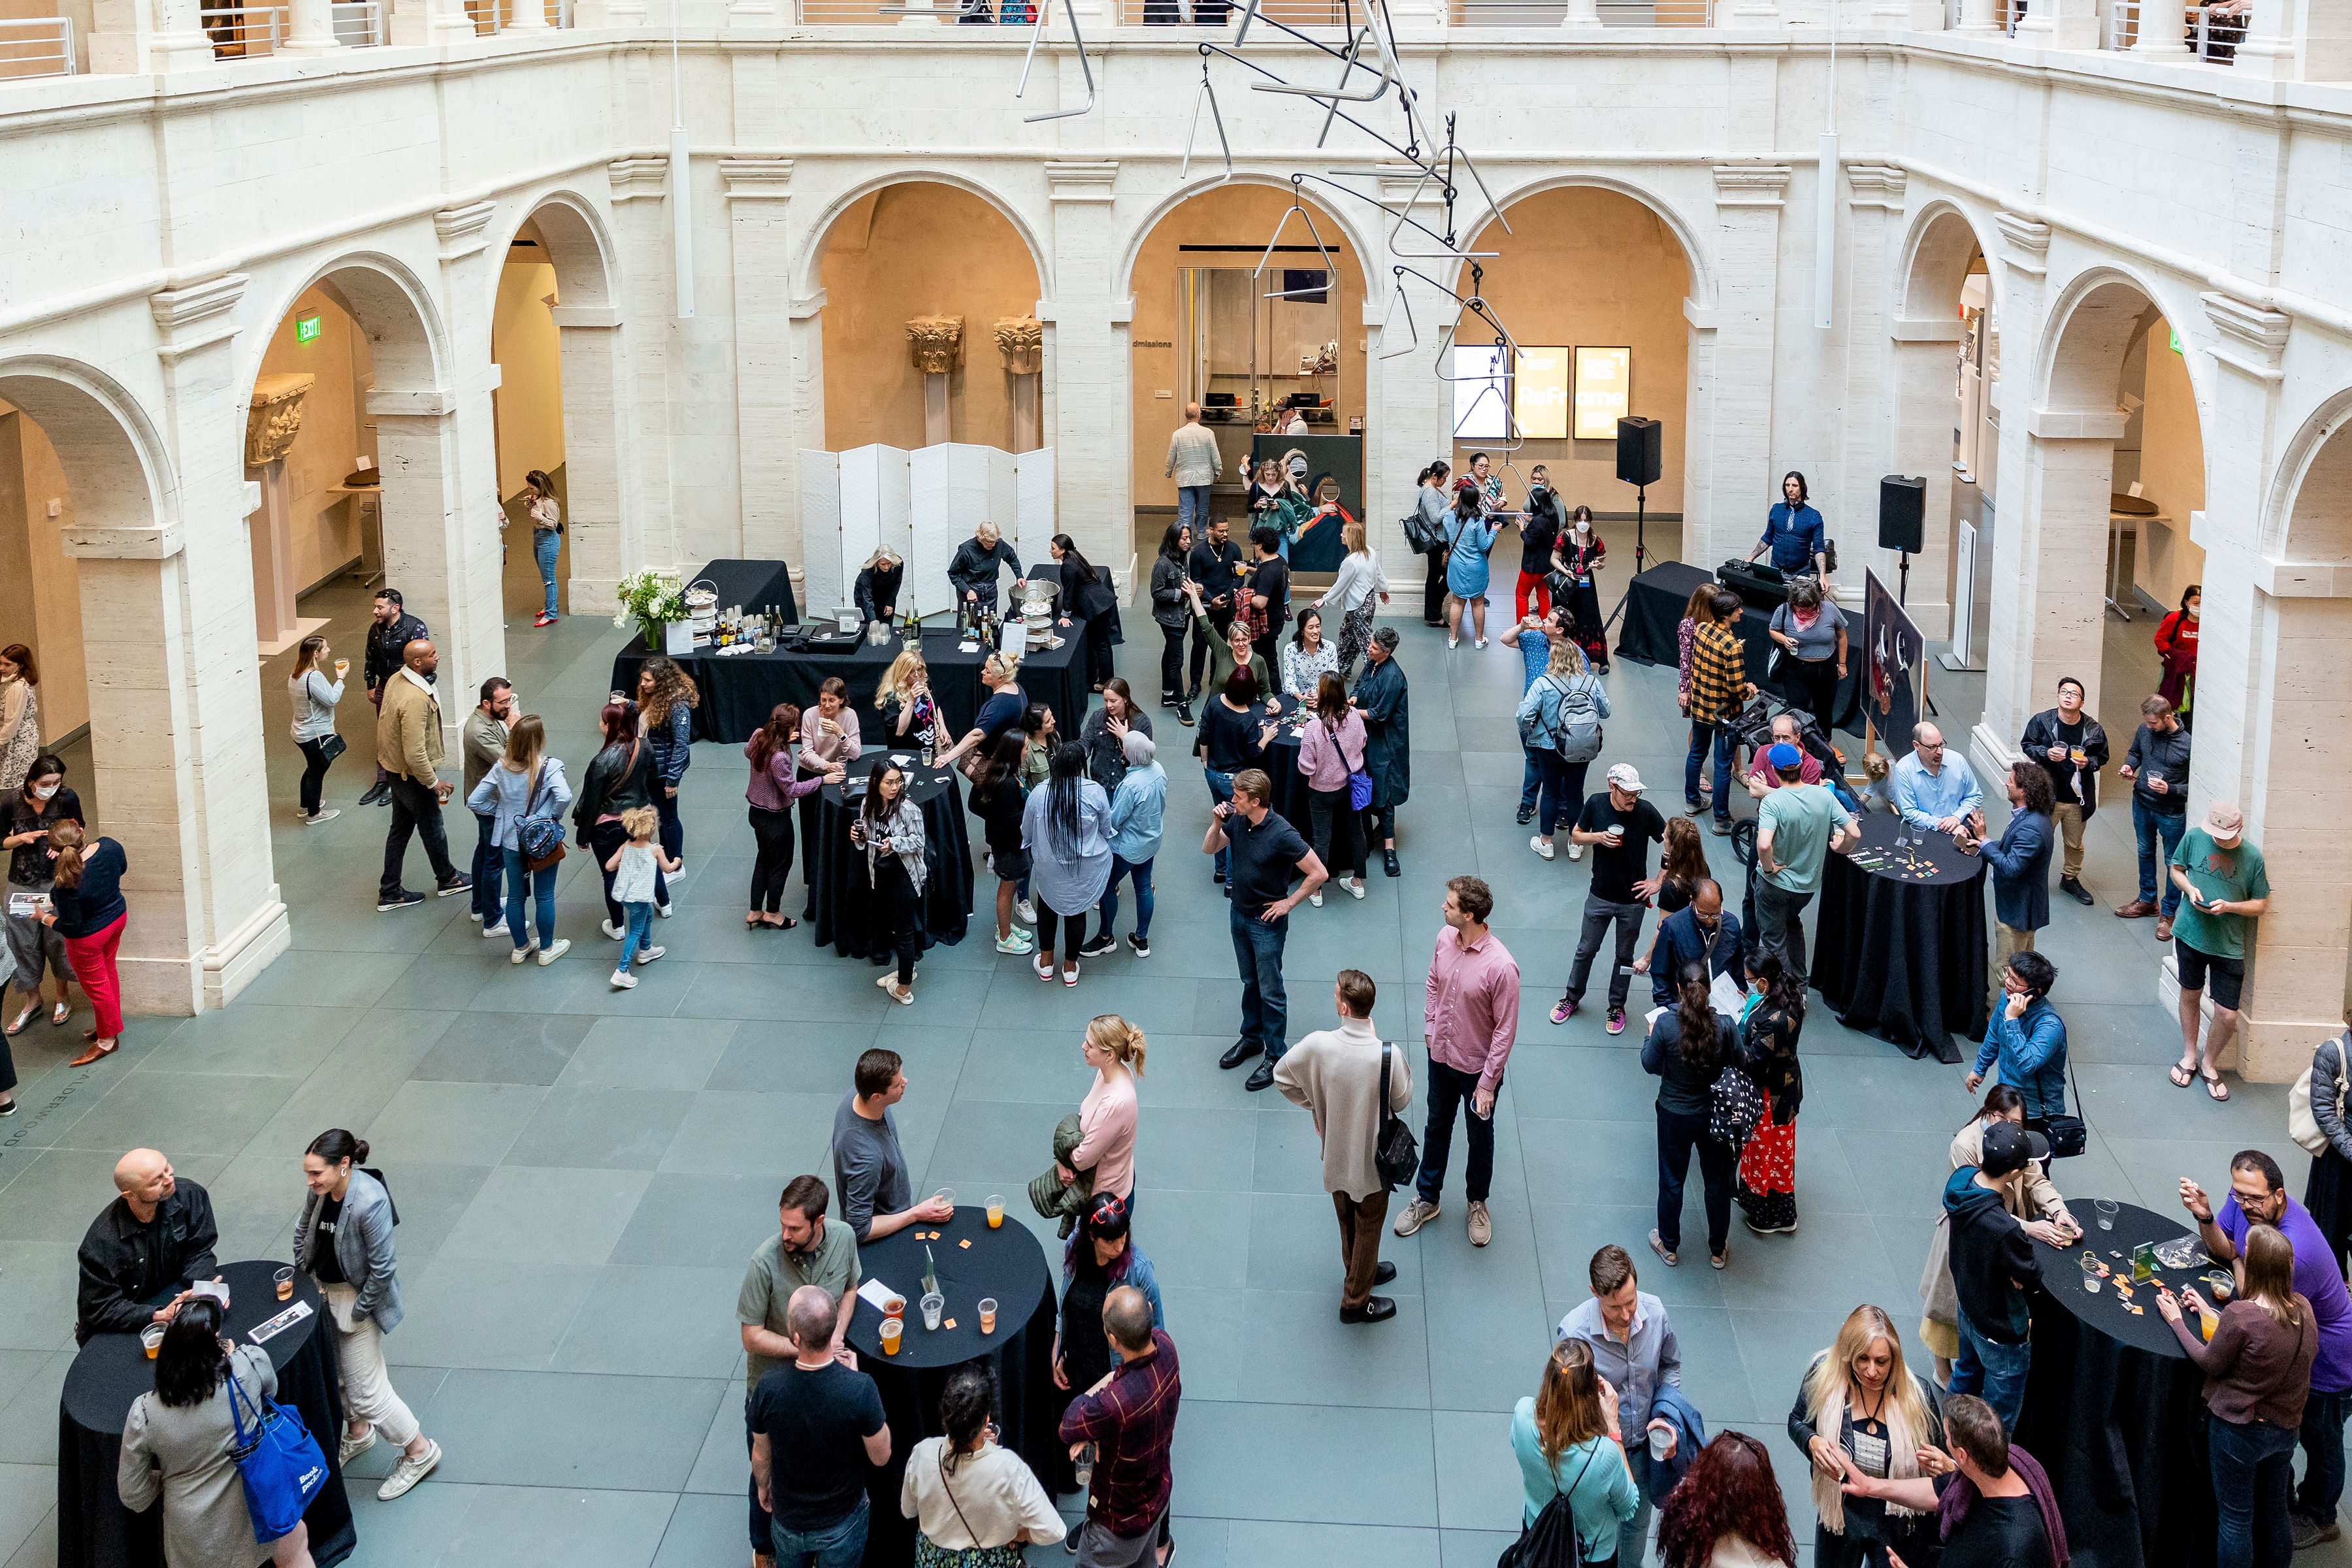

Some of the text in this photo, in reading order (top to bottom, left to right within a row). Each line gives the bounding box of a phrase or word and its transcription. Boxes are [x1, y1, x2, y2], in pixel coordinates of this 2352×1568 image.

[302, 318, 318, 338] EXIT
[1846, 850, 1871, 858] Harvard
[299, 1465, 319, 1484] Book
